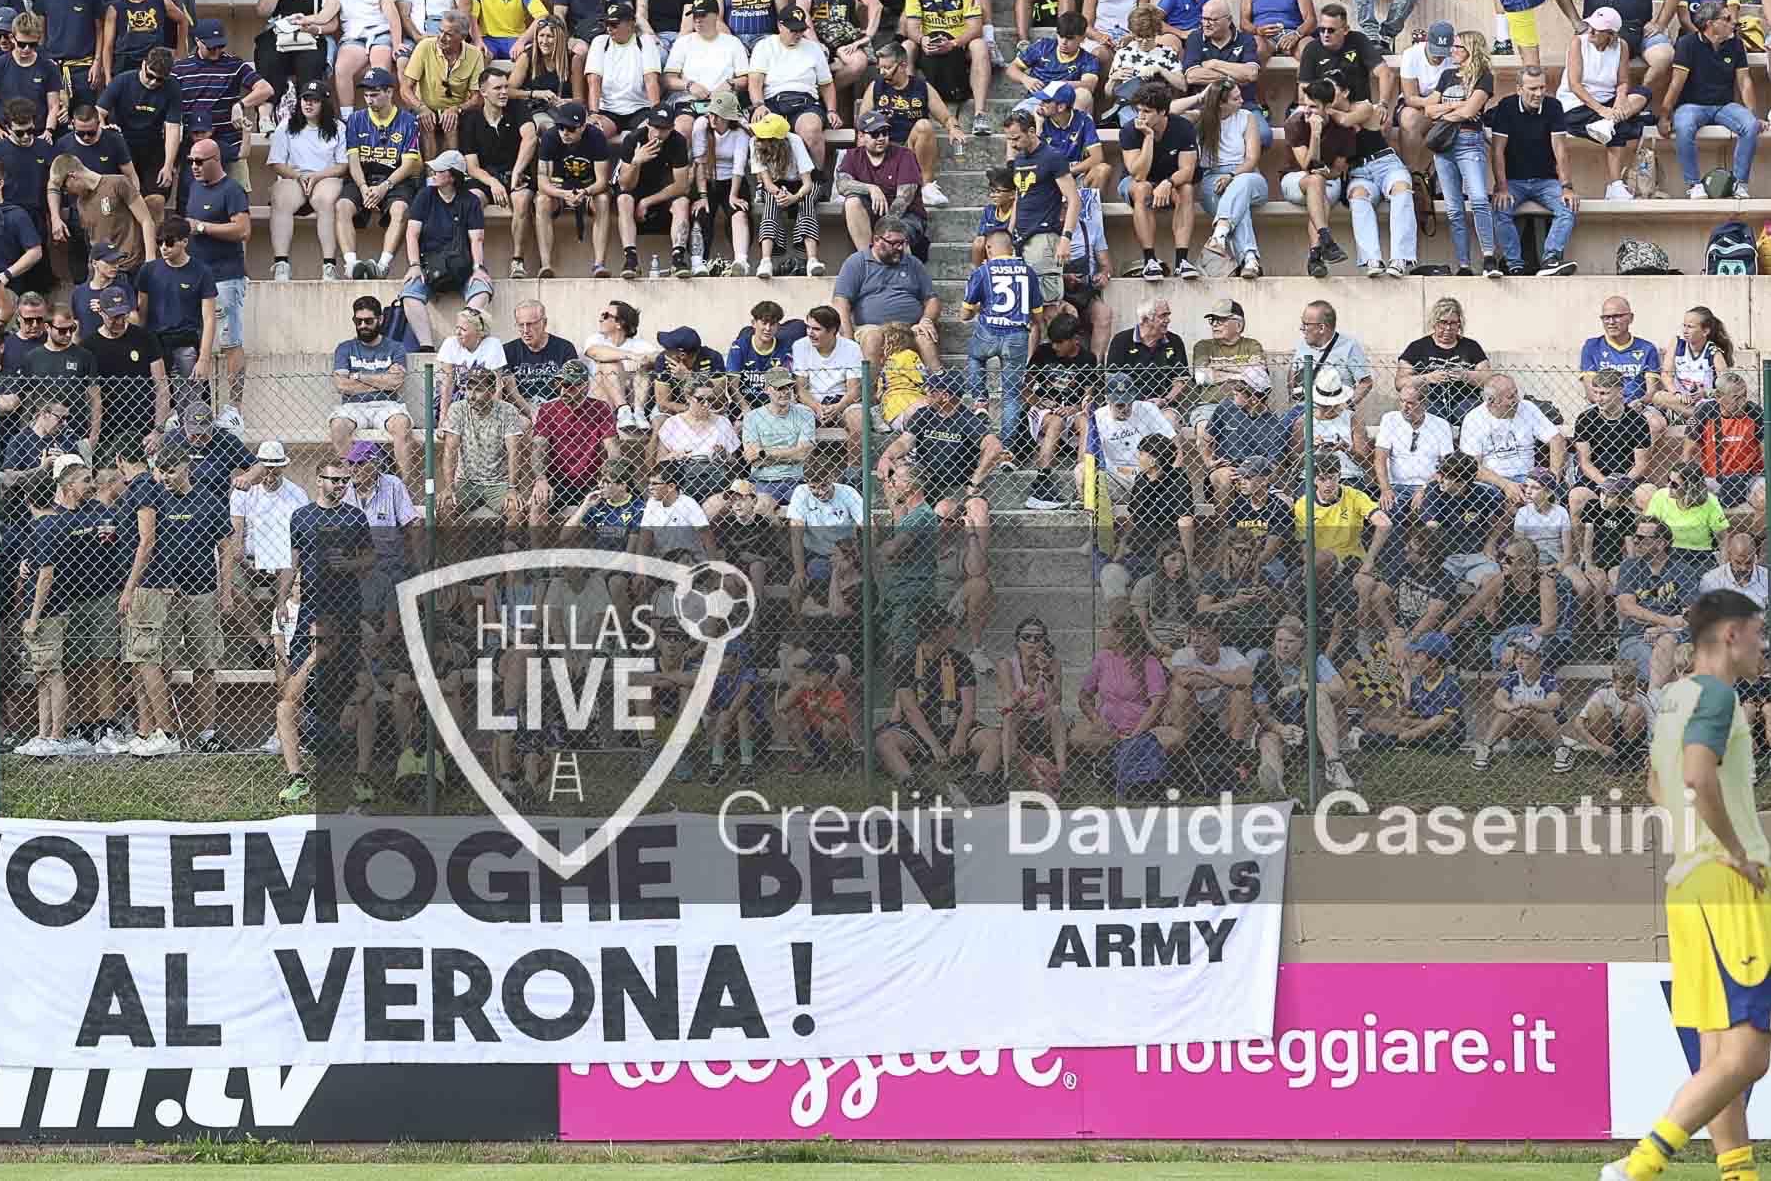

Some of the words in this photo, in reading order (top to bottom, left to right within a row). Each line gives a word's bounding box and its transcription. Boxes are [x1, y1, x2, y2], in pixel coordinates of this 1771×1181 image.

[926, 14, 963, 27] Sinergy
[1438, 36, 1447, 45] M
[990, 265, 1027, 276] SUSLOV
[993, 276, 1029, 315] 31
[744, 370, 766, 384] Sine
[1600, 361, 1642, 373] Sinergy
[736, 819, 956, 919] BEN
[1022, 860, 1261, 912] HELLAS
[1047, 917, 1237, 969] ARMY
[74, 952, 221, 1047] AL
[1136, 1013, 1556, 1089] noleggiare.it
